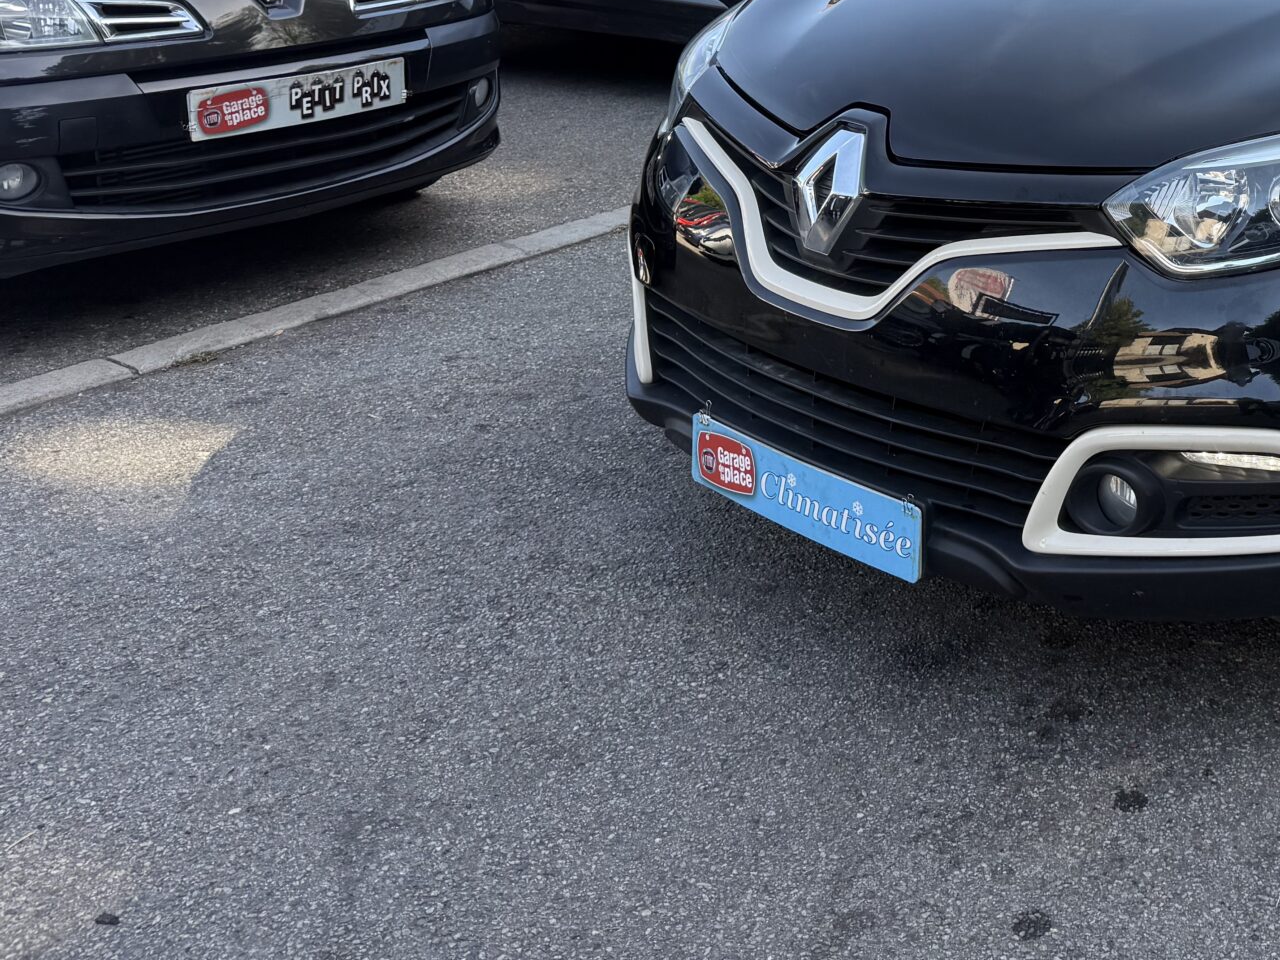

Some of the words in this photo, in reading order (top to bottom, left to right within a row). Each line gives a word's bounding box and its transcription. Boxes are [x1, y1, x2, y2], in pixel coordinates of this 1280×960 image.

[222, 94, 263, 114] Garage
[291, 82, 343, 115] PETIT
[353, 76, 390, 104] PRIX
[232, 105, 265, 126] place
[717, 446, 751, 471] Garage
[724, 466, 752, 488] place
[760, 470, 913, 559] Climatisée
